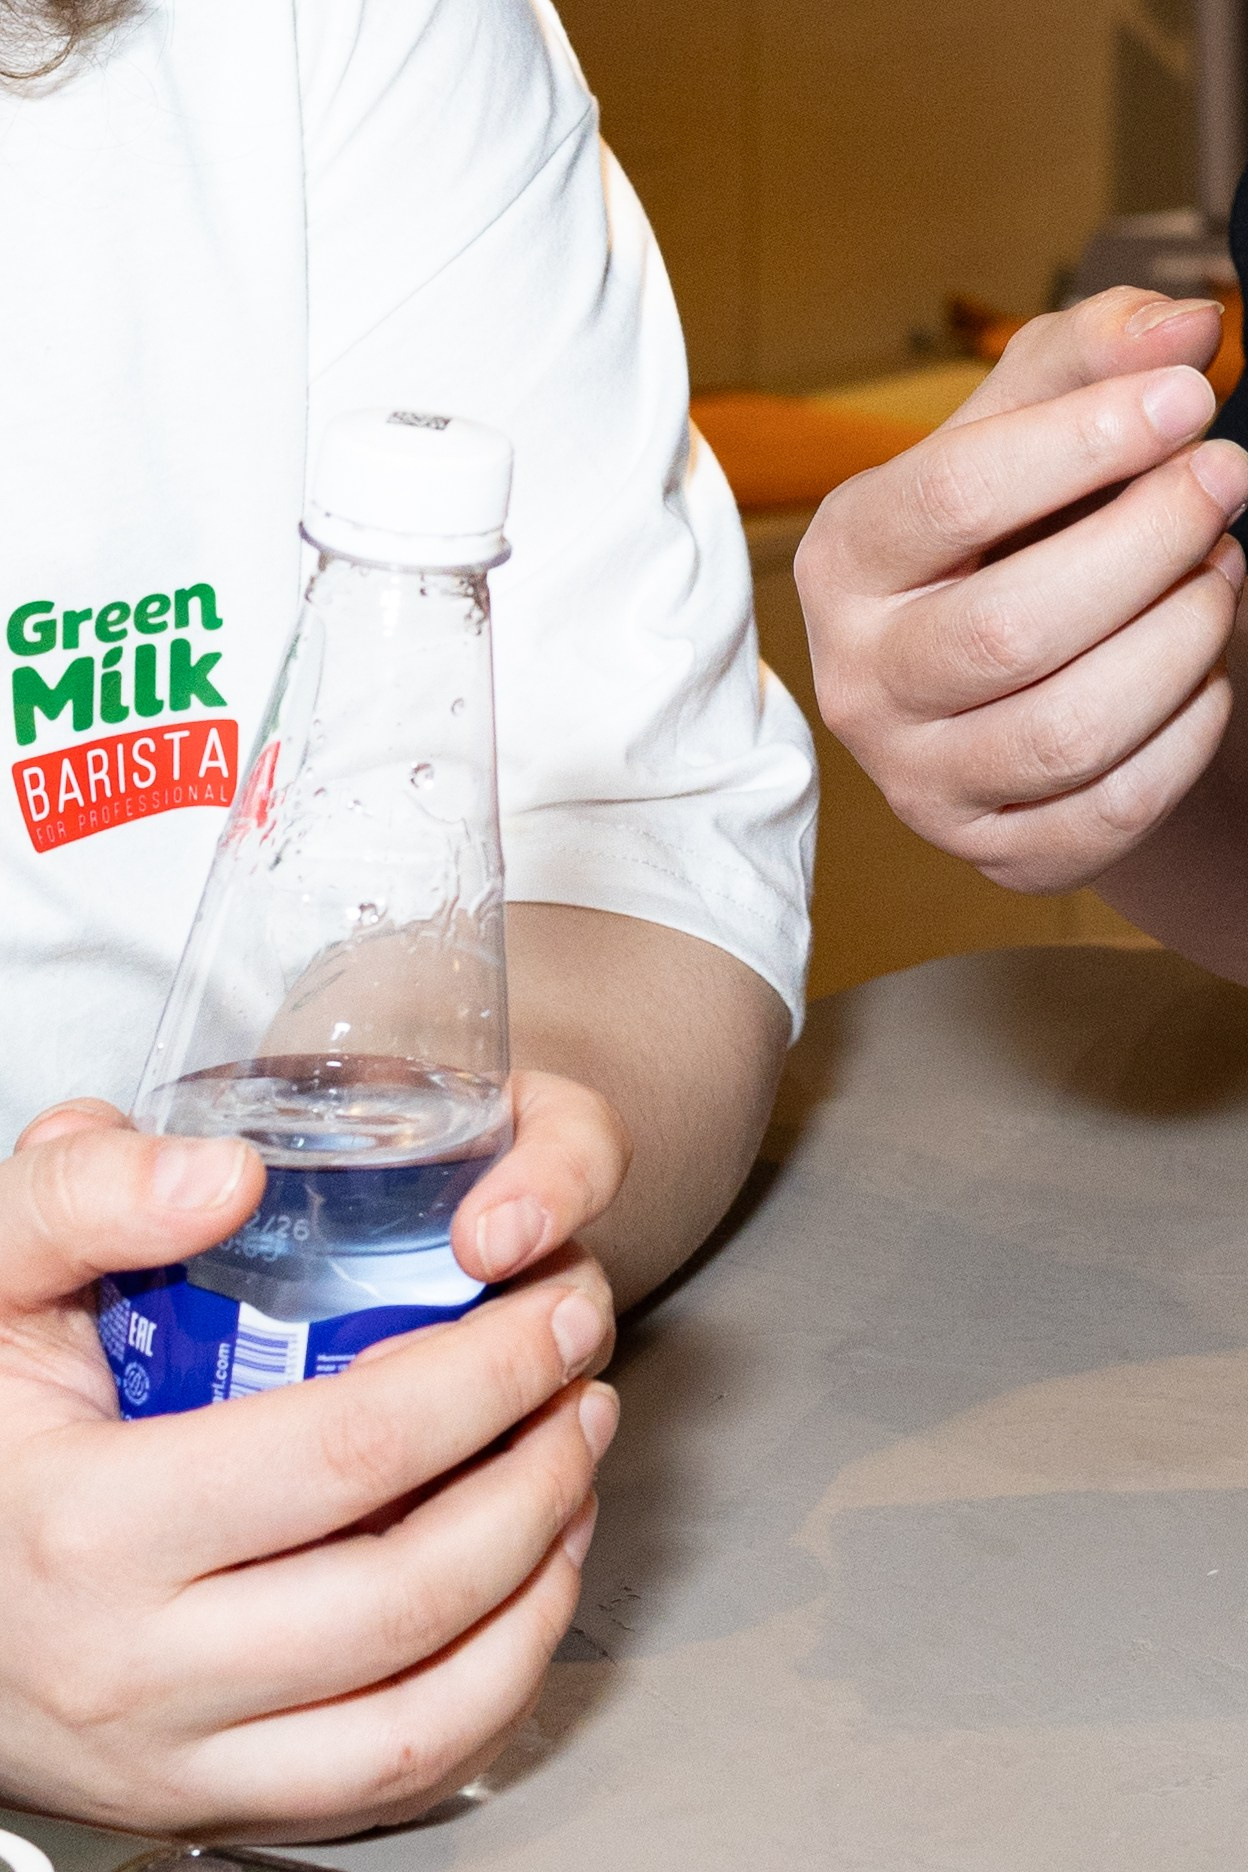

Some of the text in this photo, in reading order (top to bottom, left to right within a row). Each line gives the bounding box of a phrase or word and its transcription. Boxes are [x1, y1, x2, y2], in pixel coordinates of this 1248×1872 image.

[6, 582, 224, 657] Green
[12, 638, 228, 746] Milk
[23, 727, 229, 822] BARISTA
[36, 783, 229, 846] FOR PROFESSIONAL
